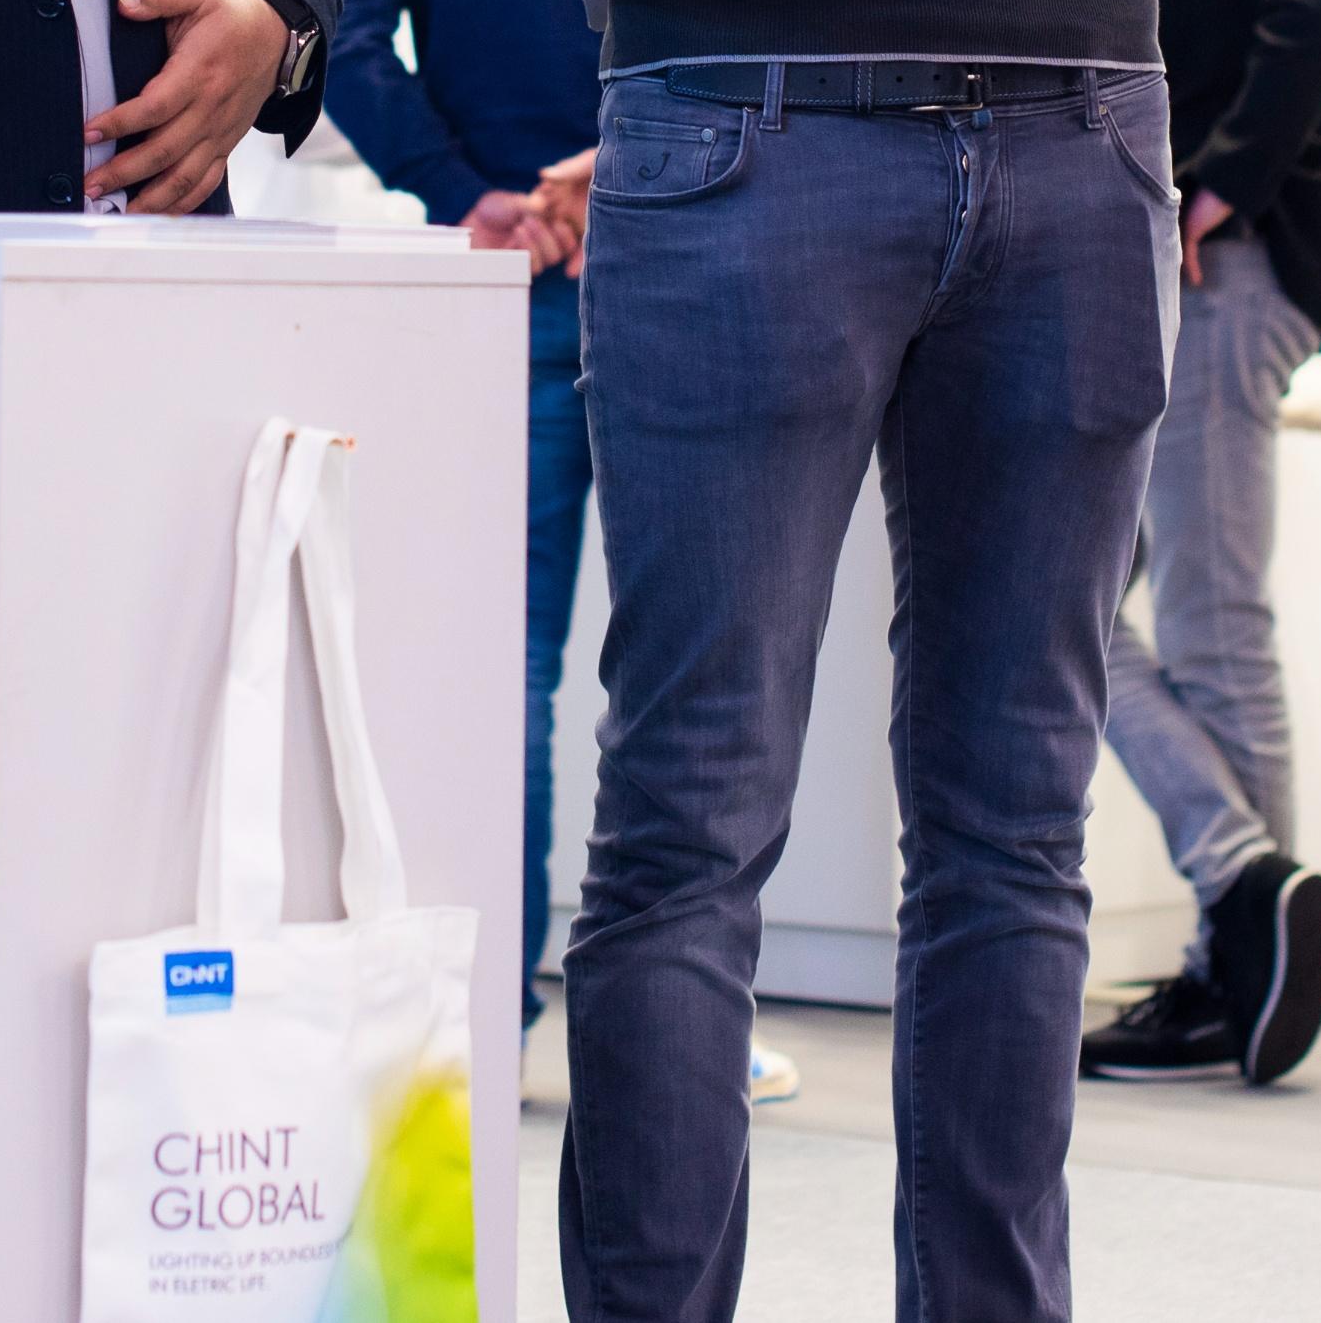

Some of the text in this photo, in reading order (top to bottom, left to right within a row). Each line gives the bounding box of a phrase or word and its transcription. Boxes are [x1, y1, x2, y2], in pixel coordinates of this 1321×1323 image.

[154, 1126, 299, 1177] CHINT
[151, 1179, 325, 1230] GLOBAL
[149, 1251, 233, 1270] LIGHTING
[237, 1251, 255, 1269] UP
[149, 1278, 168, 1294] IN
